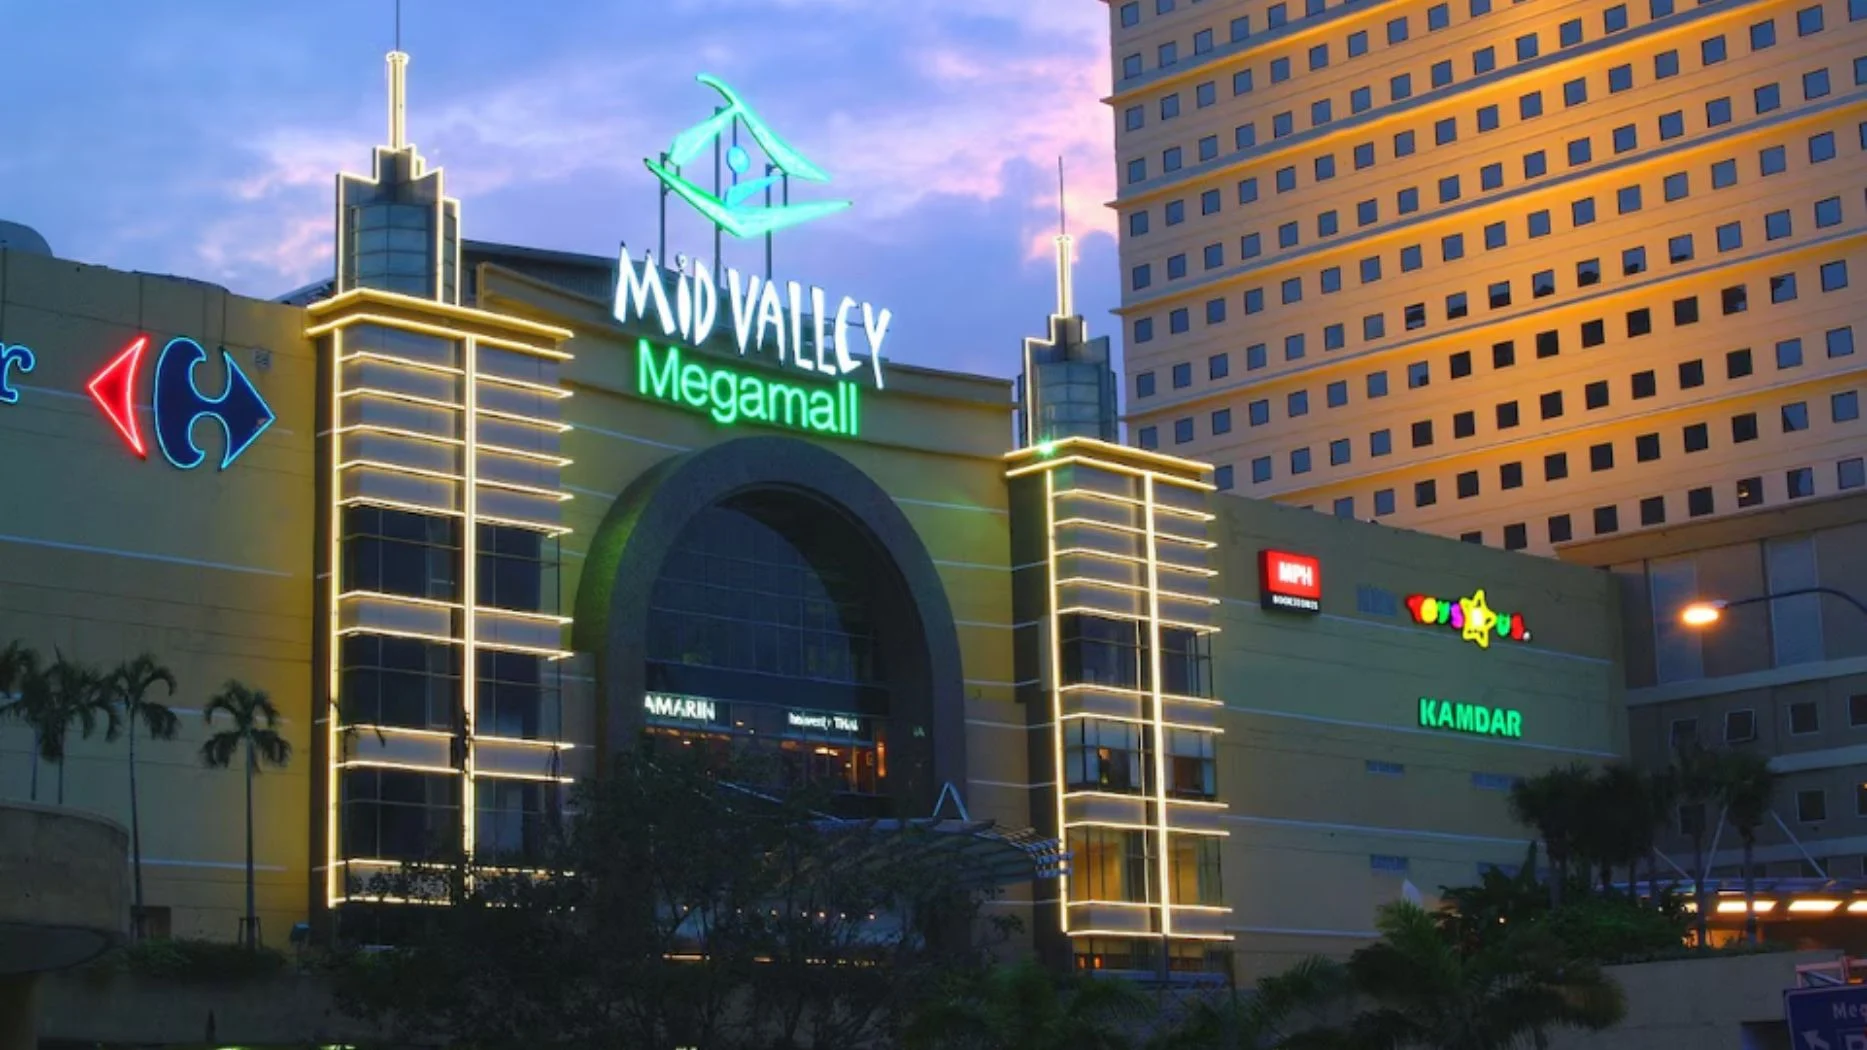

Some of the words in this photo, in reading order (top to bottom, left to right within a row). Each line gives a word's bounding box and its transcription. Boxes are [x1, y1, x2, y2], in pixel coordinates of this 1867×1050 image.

[724, 267, 892, 390] VALLEY
[637, 338, 859, 436] Megamall
[1278, 560, 1313, 587] MPH
[1418, 698, 1523, 738] KAMDAR
